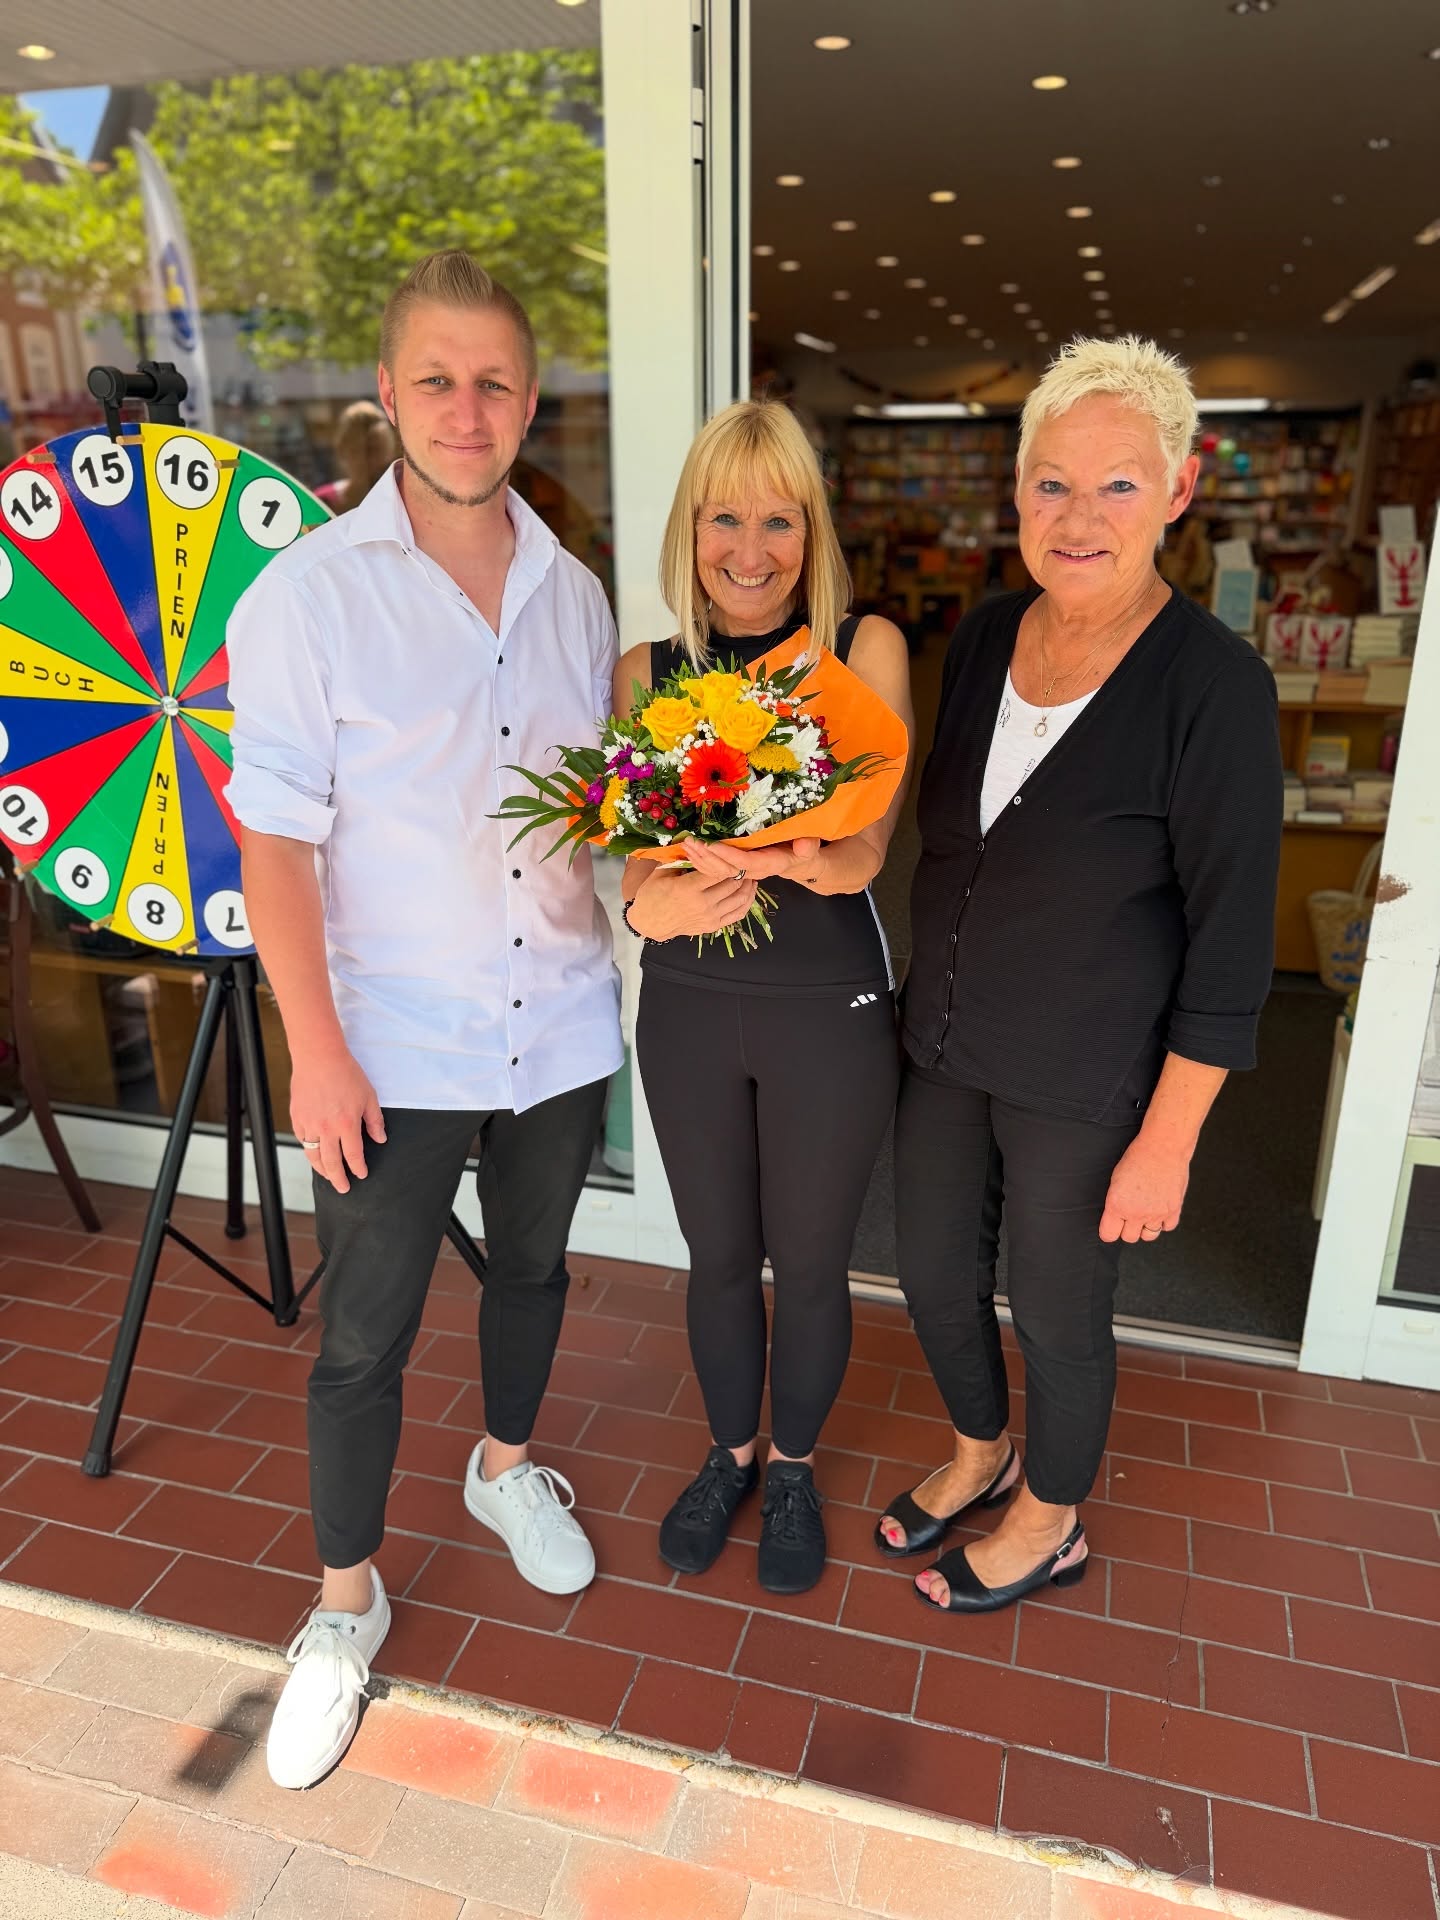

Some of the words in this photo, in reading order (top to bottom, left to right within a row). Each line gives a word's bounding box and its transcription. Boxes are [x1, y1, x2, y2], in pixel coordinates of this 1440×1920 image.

[79, 452, 125, 489] 15
[163, 454, 209, 492] 16
[10, 481, 53, 527] 14
[260, 499, 281, 529] 1
[170, 523, 188, 639] PRIEN
[9, 660, 94, 692] BUCH
[3, 793, 38, 836] 10
[153, 772, 169, 875] PRIEN
[71, 864, 93, 889] 9
[145, 900, 165, 926] 8
[225, 906, 245, 932] 7
